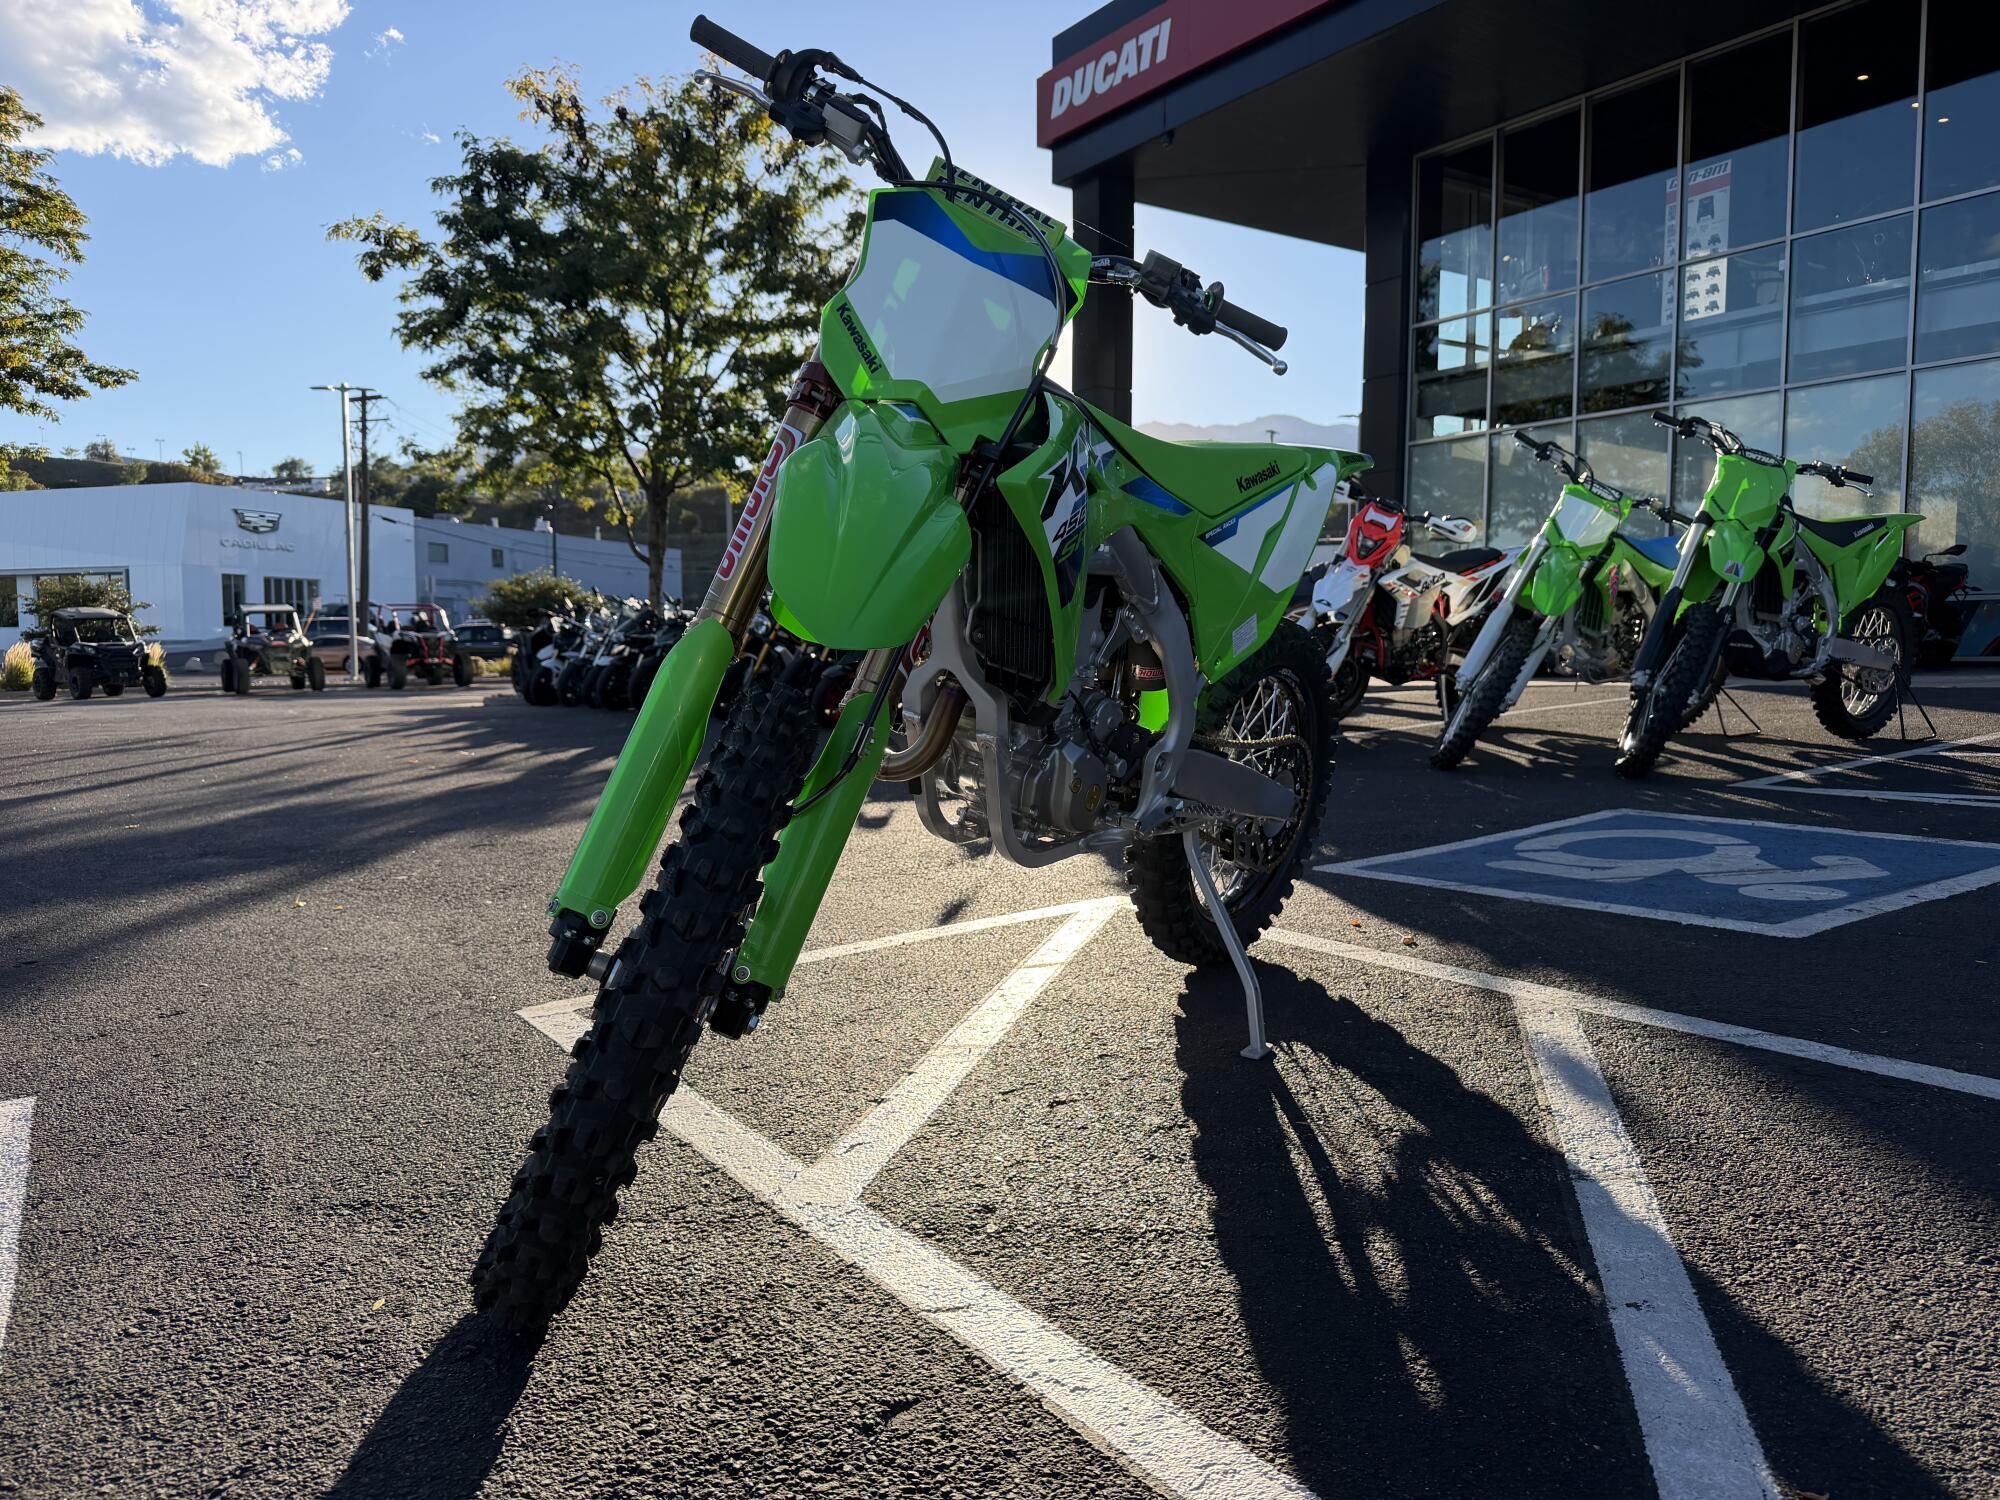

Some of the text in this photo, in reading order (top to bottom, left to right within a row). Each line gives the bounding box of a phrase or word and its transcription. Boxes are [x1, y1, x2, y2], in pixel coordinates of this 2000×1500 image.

[1051, 18, 1171, 119] DUCATI
[836, 302, 882, 375] Kawasaki
[1236, 460, 1281, 494] Kawasaki
[220, 538, 295, 553] CADILLAC
